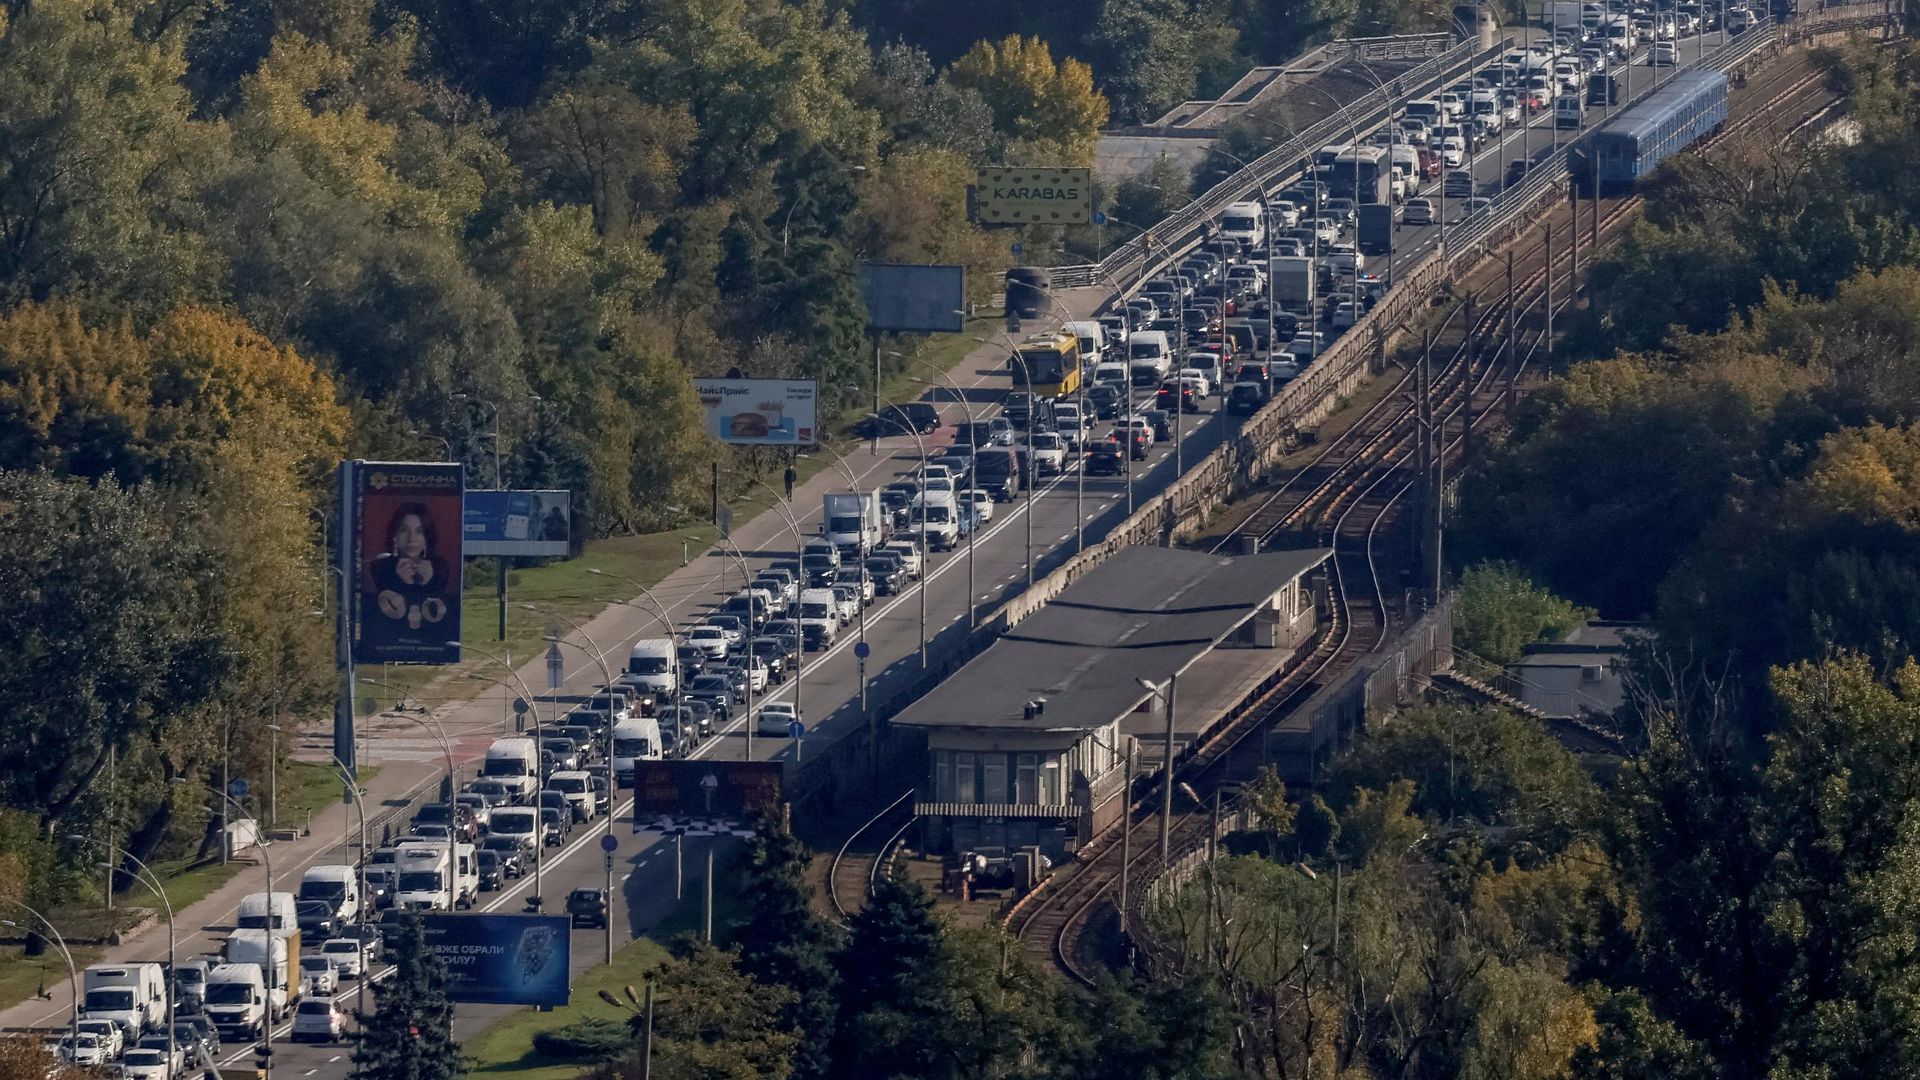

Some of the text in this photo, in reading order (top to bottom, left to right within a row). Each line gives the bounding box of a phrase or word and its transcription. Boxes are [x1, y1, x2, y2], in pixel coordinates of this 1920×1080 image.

[993, 187, 1078, 200] KARABAS
[391, 474, 457, 483] СТОЛИЧНА
[461, 945, 504, 954] ОБРАЛИ
